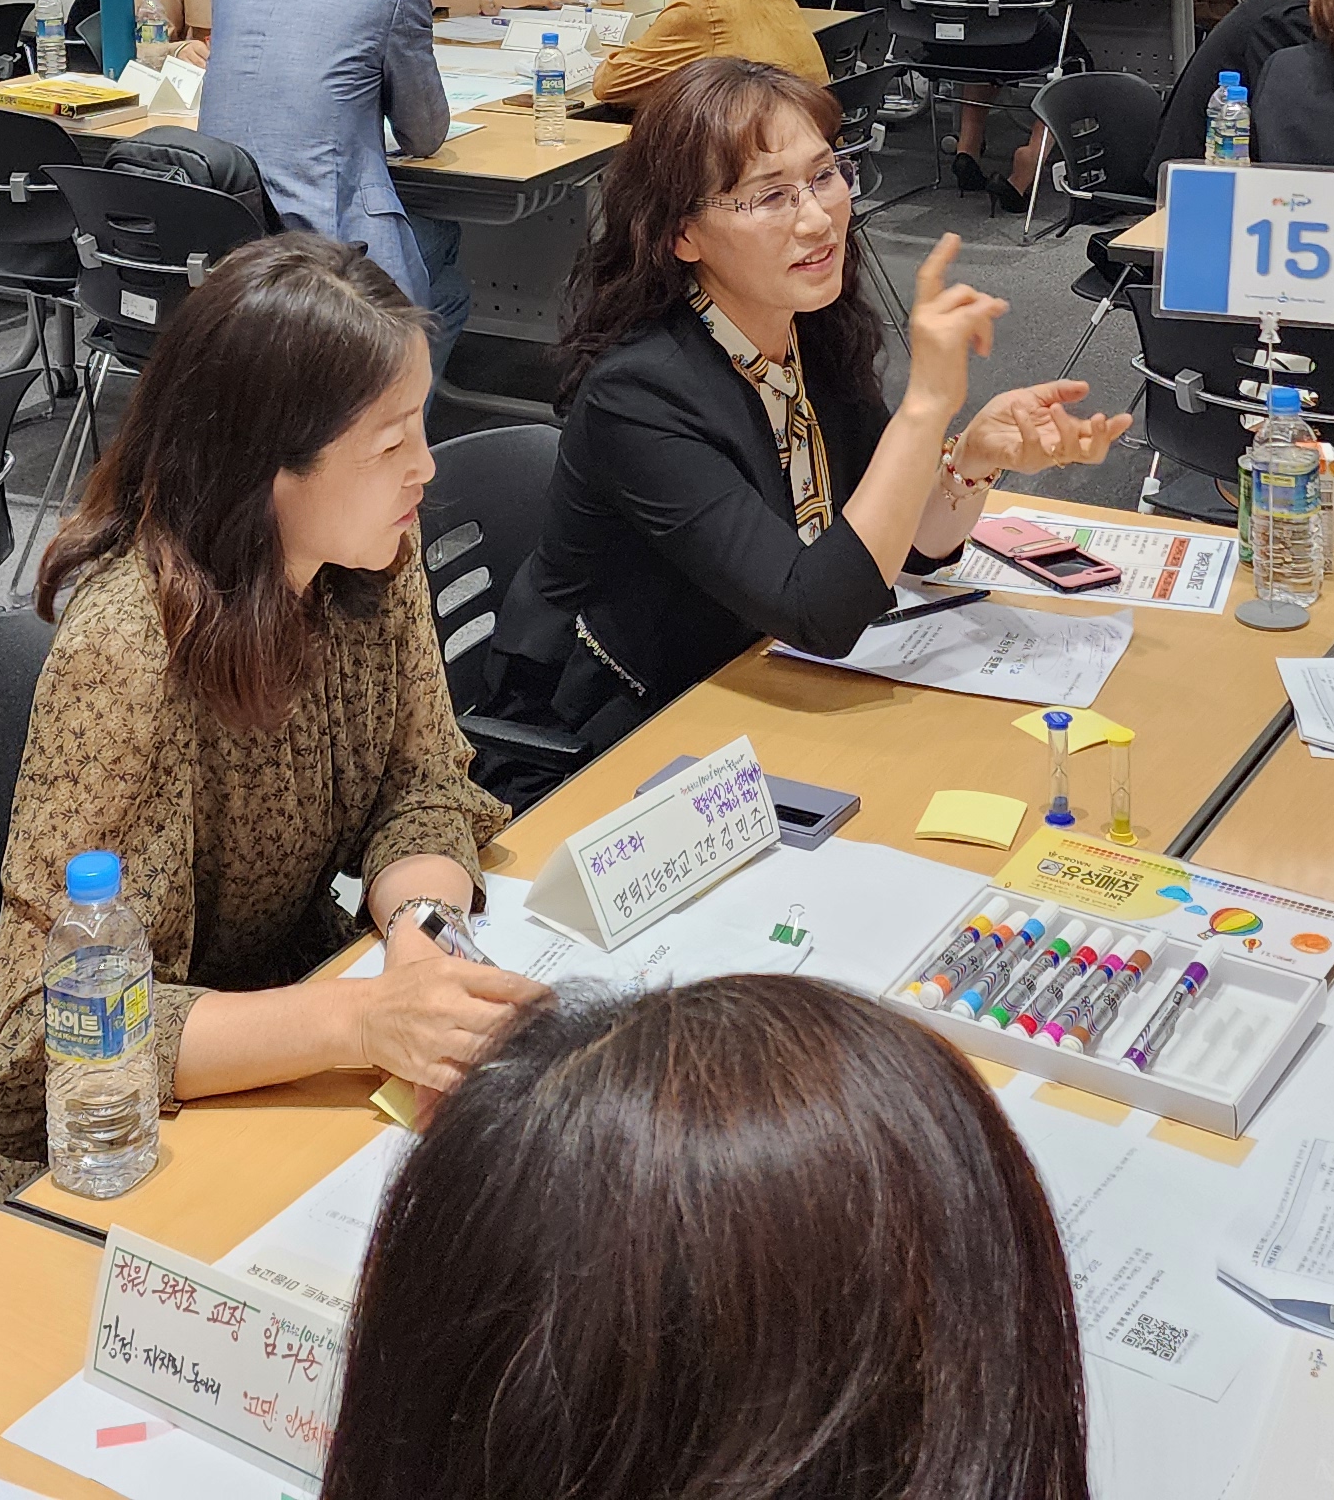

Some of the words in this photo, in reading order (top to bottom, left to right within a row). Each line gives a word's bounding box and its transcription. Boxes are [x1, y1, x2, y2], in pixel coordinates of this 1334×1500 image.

[1246, 218, 1332, 280] 15
[693, 832, 718, 868] 교장
[720, 820, 737, 852] 김
[1057, 854, 1092, 868] CROWN
[1060, 865, 1140, 899] 유성매직
[1104, 891, 1128, 904] INK
[46, 1003, 103, 1038] 화이트
[246, 1263, 301, 1292] 마을교육
[113, 1252, 152, 1298] 창원
[206, 1301, 249, 1342] 교장
